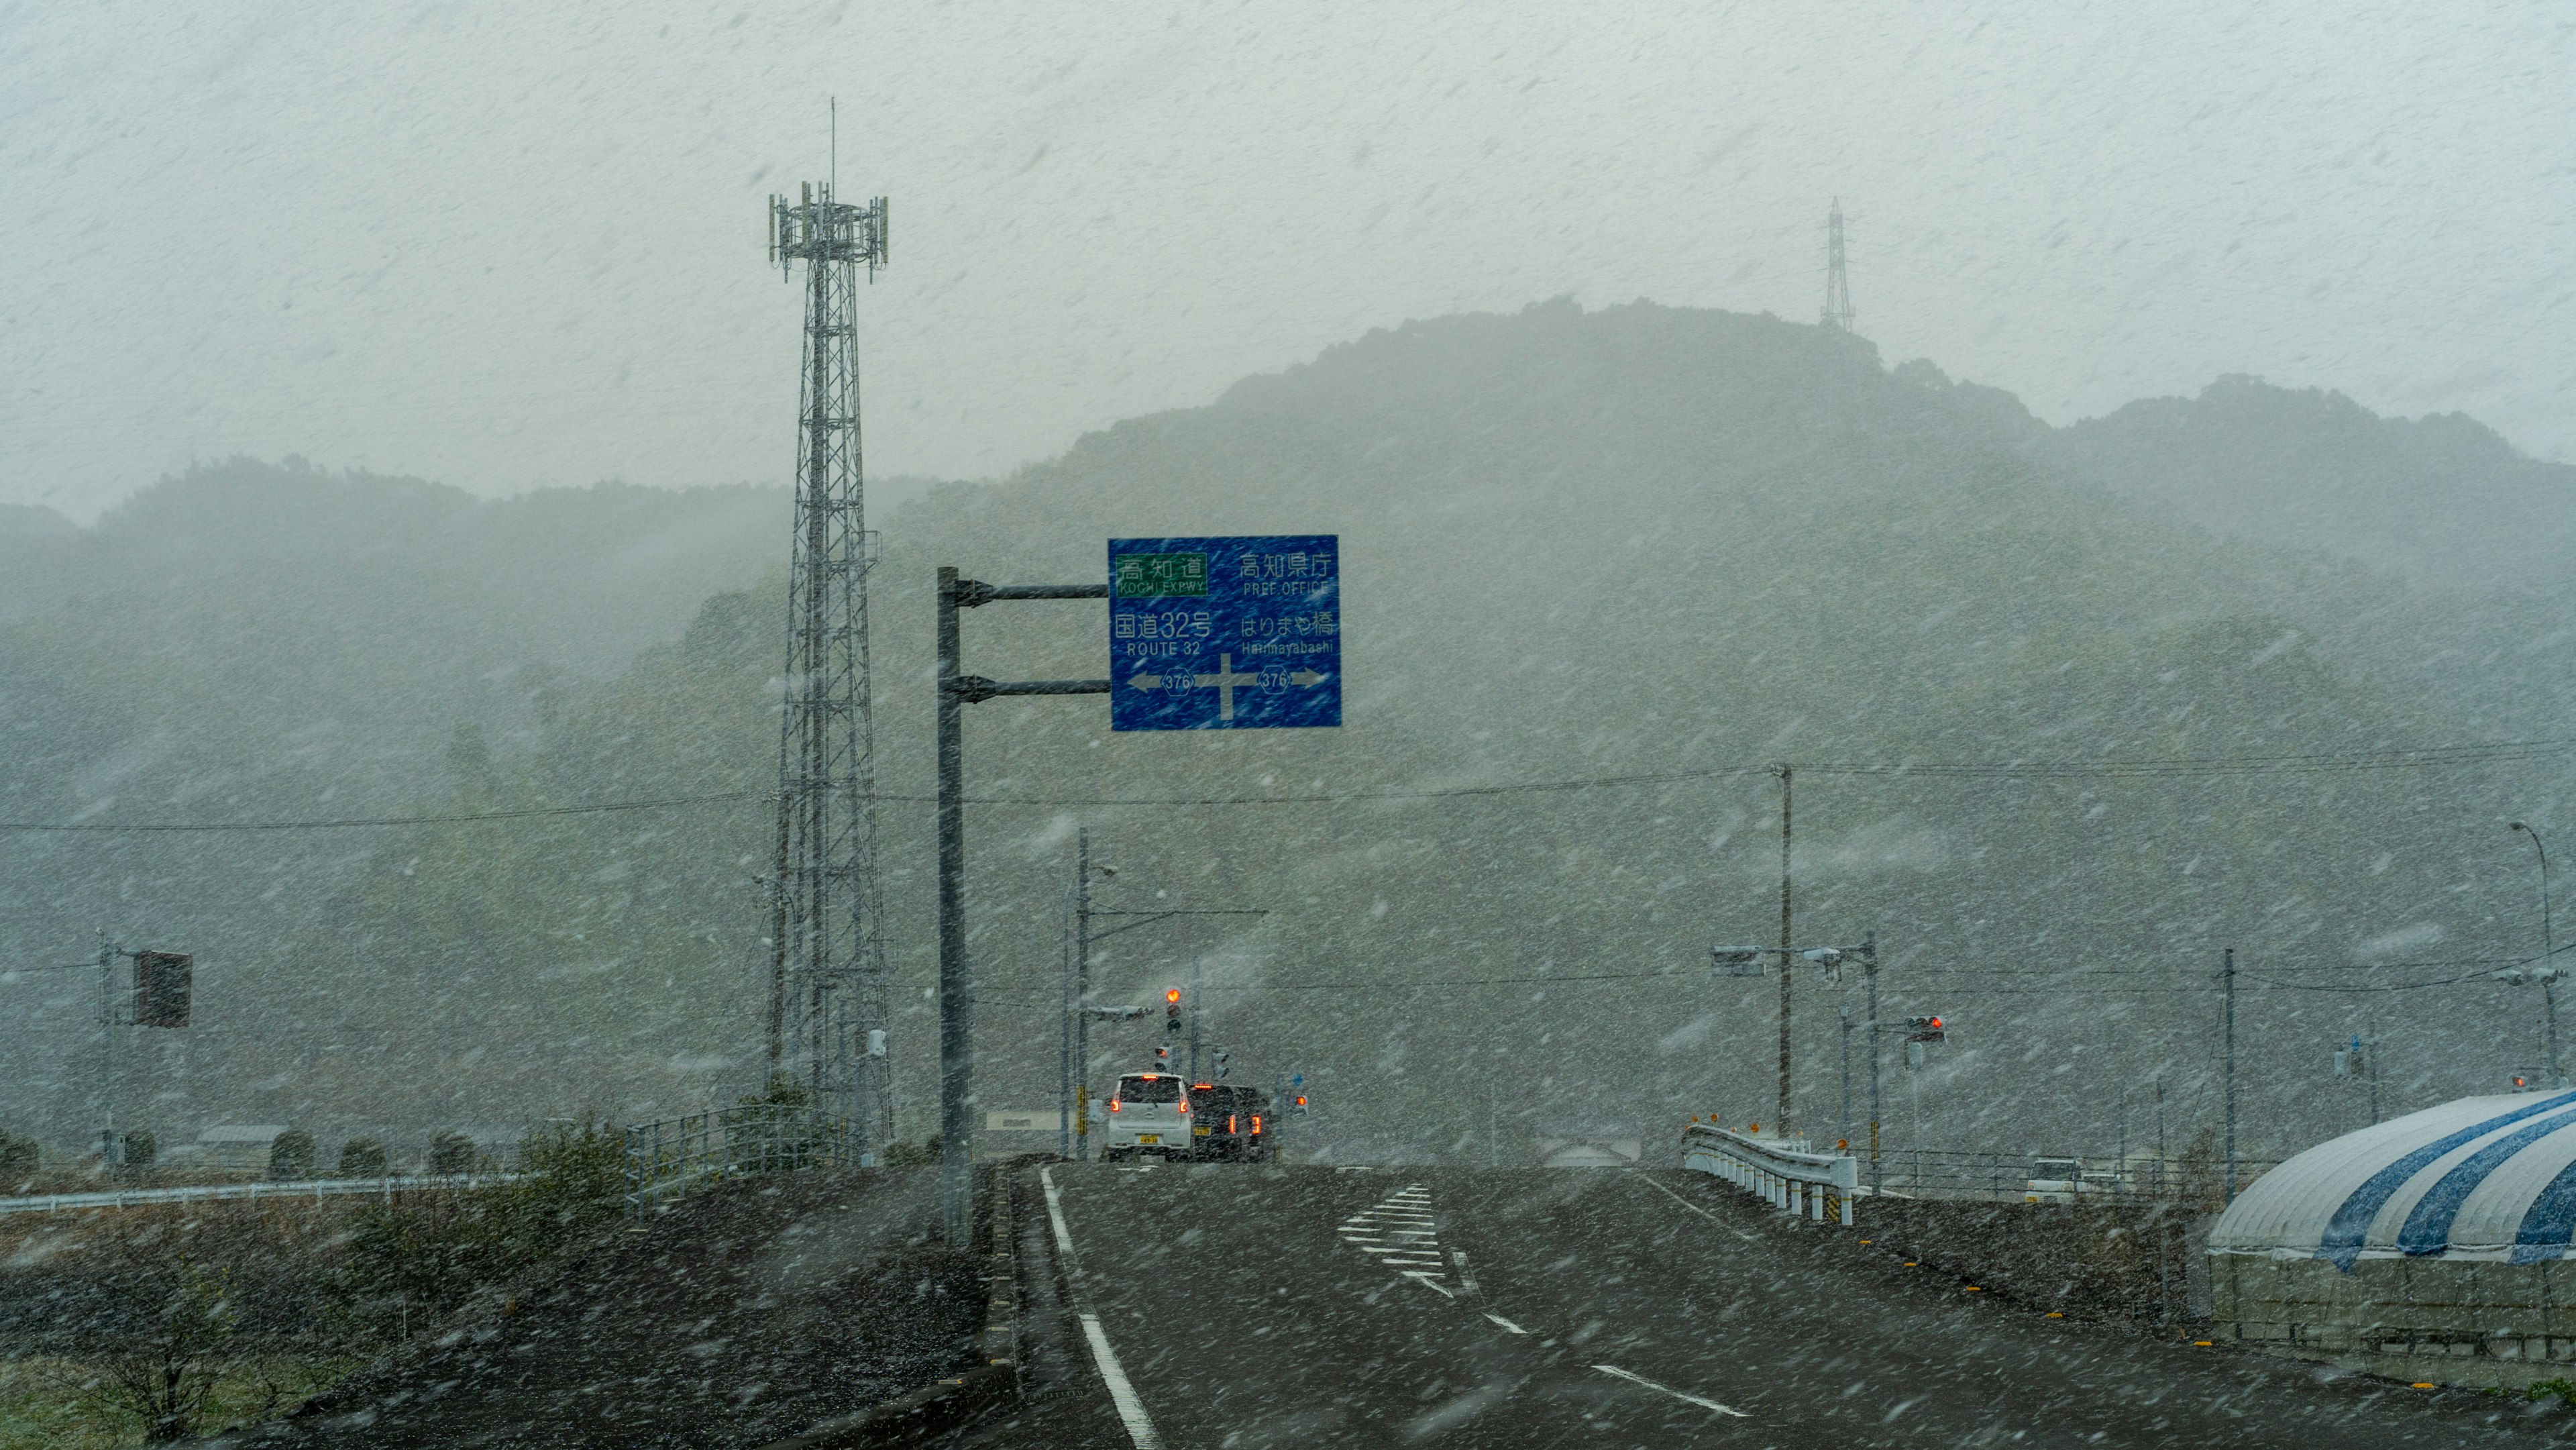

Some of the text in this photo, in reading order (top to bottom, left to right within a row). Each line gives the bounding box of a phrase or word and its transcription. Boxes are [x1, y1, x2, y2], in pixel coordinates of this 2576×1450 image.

[1120, 558, 1202, 579] 高知道
[1240, 552, 1332, 578] 高知県庁
[1120, 581, 1203, 594] KOCHI EXPWY
[1282, 581, 1328, 595] OFFICE
[1116, 612, 1212, 638] 国道32号
[1242, 611, 1334, 637] はりまや橋
[1127, 641, 1200, 656] ROUTE 32
[1242, 640, 1333, 657] Harimayabashi
[1165, 675, 1190, 689] 376
[1262, 672, 1287, 687] 376
